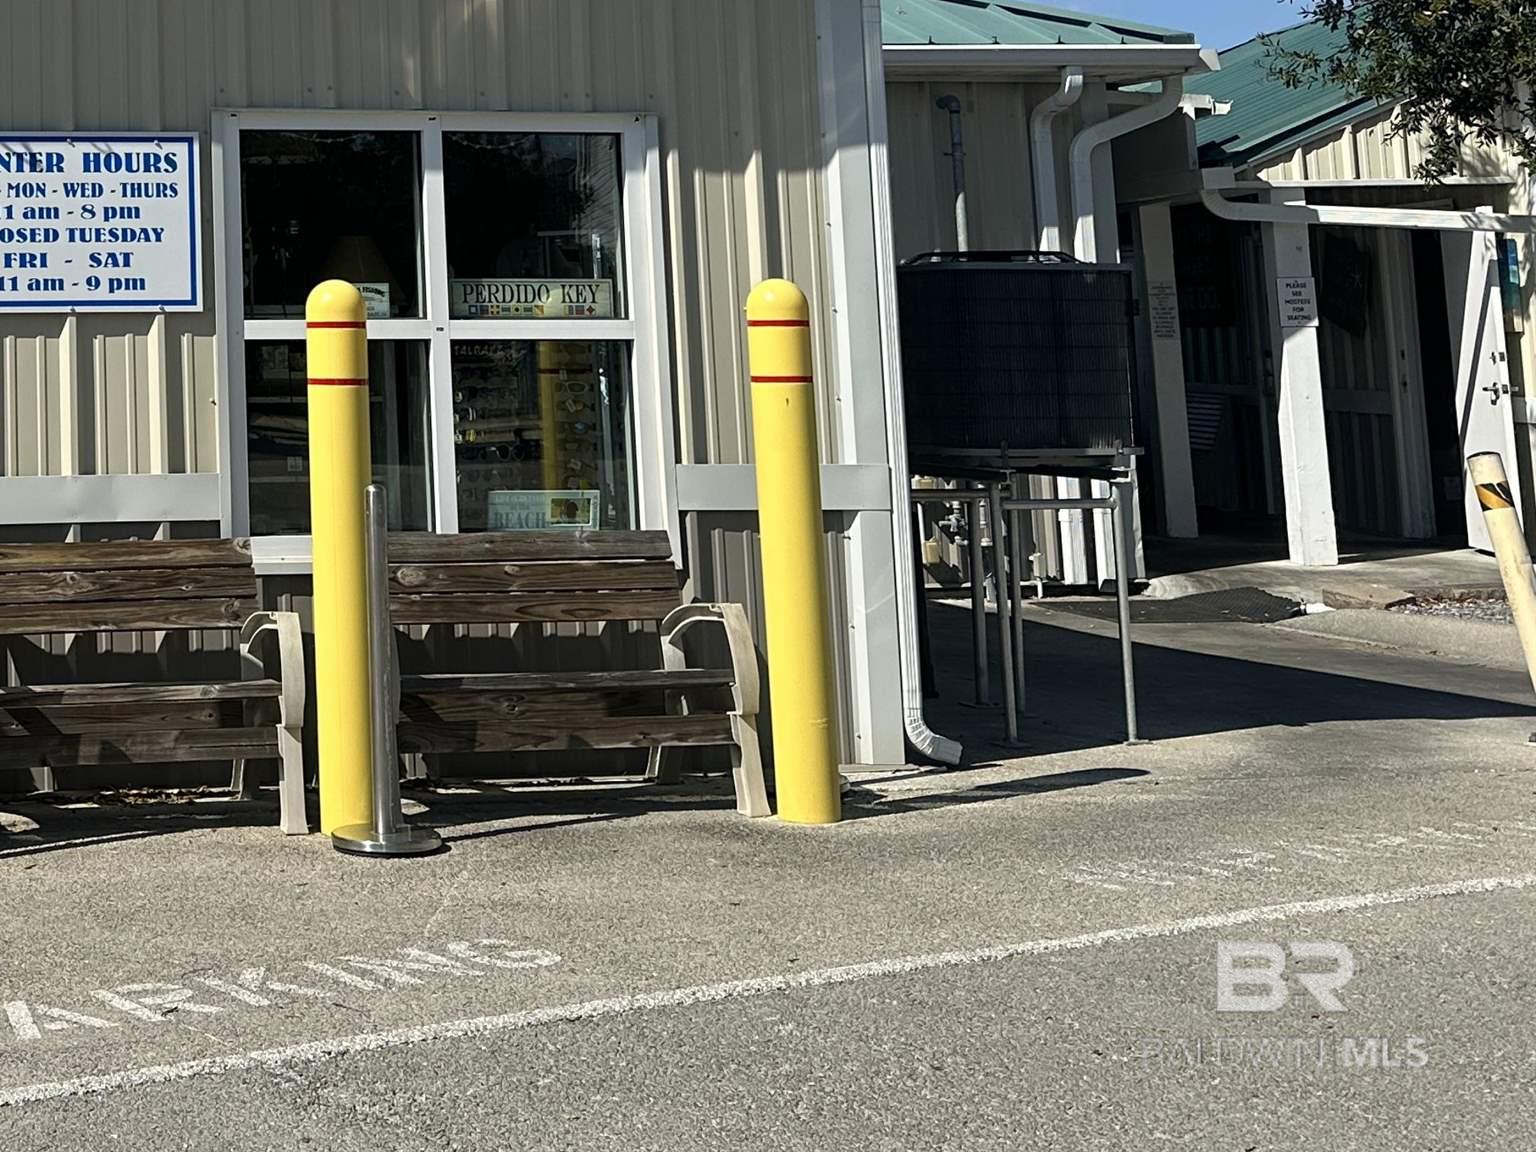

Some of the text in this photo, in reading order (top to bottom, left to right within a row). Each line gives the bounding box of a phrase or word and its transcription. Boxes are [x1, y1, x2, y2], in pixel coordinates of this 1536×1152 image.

[82, 152, 178, 174] HOURS
[7, 183, 46, 198] MON
[63, 182, 104, 198] WED
[120, 183, 178, 198] THURS
[22, 206, 60, 220] am
[80, 204, 96, 219] 8
[103, 206, 141, 221] pm
[65, 227, 165, 243] TUESDAY
[3, 252, 48, 268] FRI
[88, 252, 134, 268] SAT
[27, 277, 64, 291] am
[85, 275, 101, 291] 9
[108, 277, 146, 293] pm
[462, 284, 600, 304] PERDIDO KEY
[495, 511, 546, 529] BEACH
